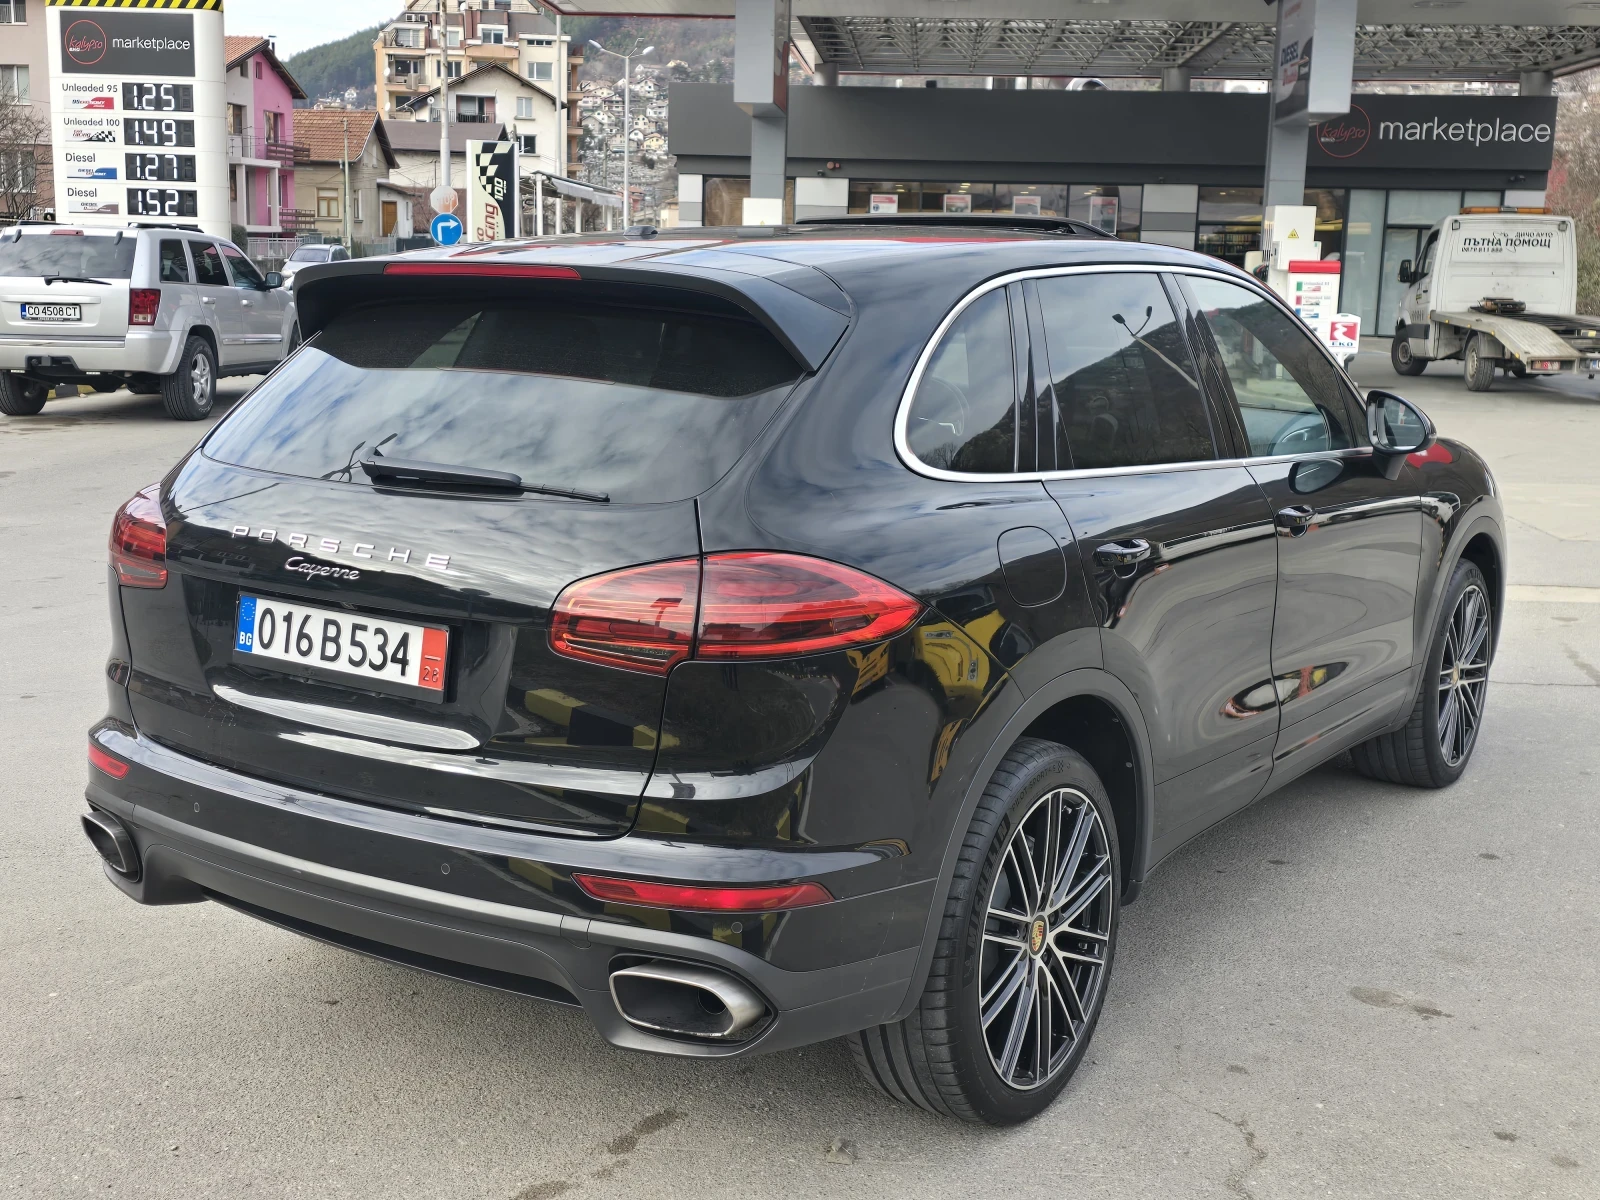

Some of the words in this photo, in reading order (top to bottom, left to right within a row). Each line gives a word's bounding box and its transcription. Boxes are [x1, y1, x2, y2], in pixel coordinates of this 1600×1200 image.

[112, 36, 191, 52] marketplace
[62, 83, 104, 93] Unleaded
[106, 84, 118, 93] 95
[63, 117, 103, 127] Unleaded
[105, 118, 120, 127] 100
[1379, 116, 1551, 147] marketplace
[65, 152, 96, 163] Diesel
[67, 187, 98, 198] Diesel
[494, 177, 504, 201] 100
[1463, 237, 1502, 247] ПЪТНА
[1505, 238, 1551, 249] ПОМОЩ
[27, 305, 40, 316] CO
[41, 306, 65, 317] 4508
[65, 306, 78, 317] CT
[231, 525, 451, 570] PORSCHE
[284, 556, 361, 581] Cayenne
[239, 631, 252, 645] BG
[258, 606, 411, 677] 016B534
[1029, 769, 1049, 789] SPORT
